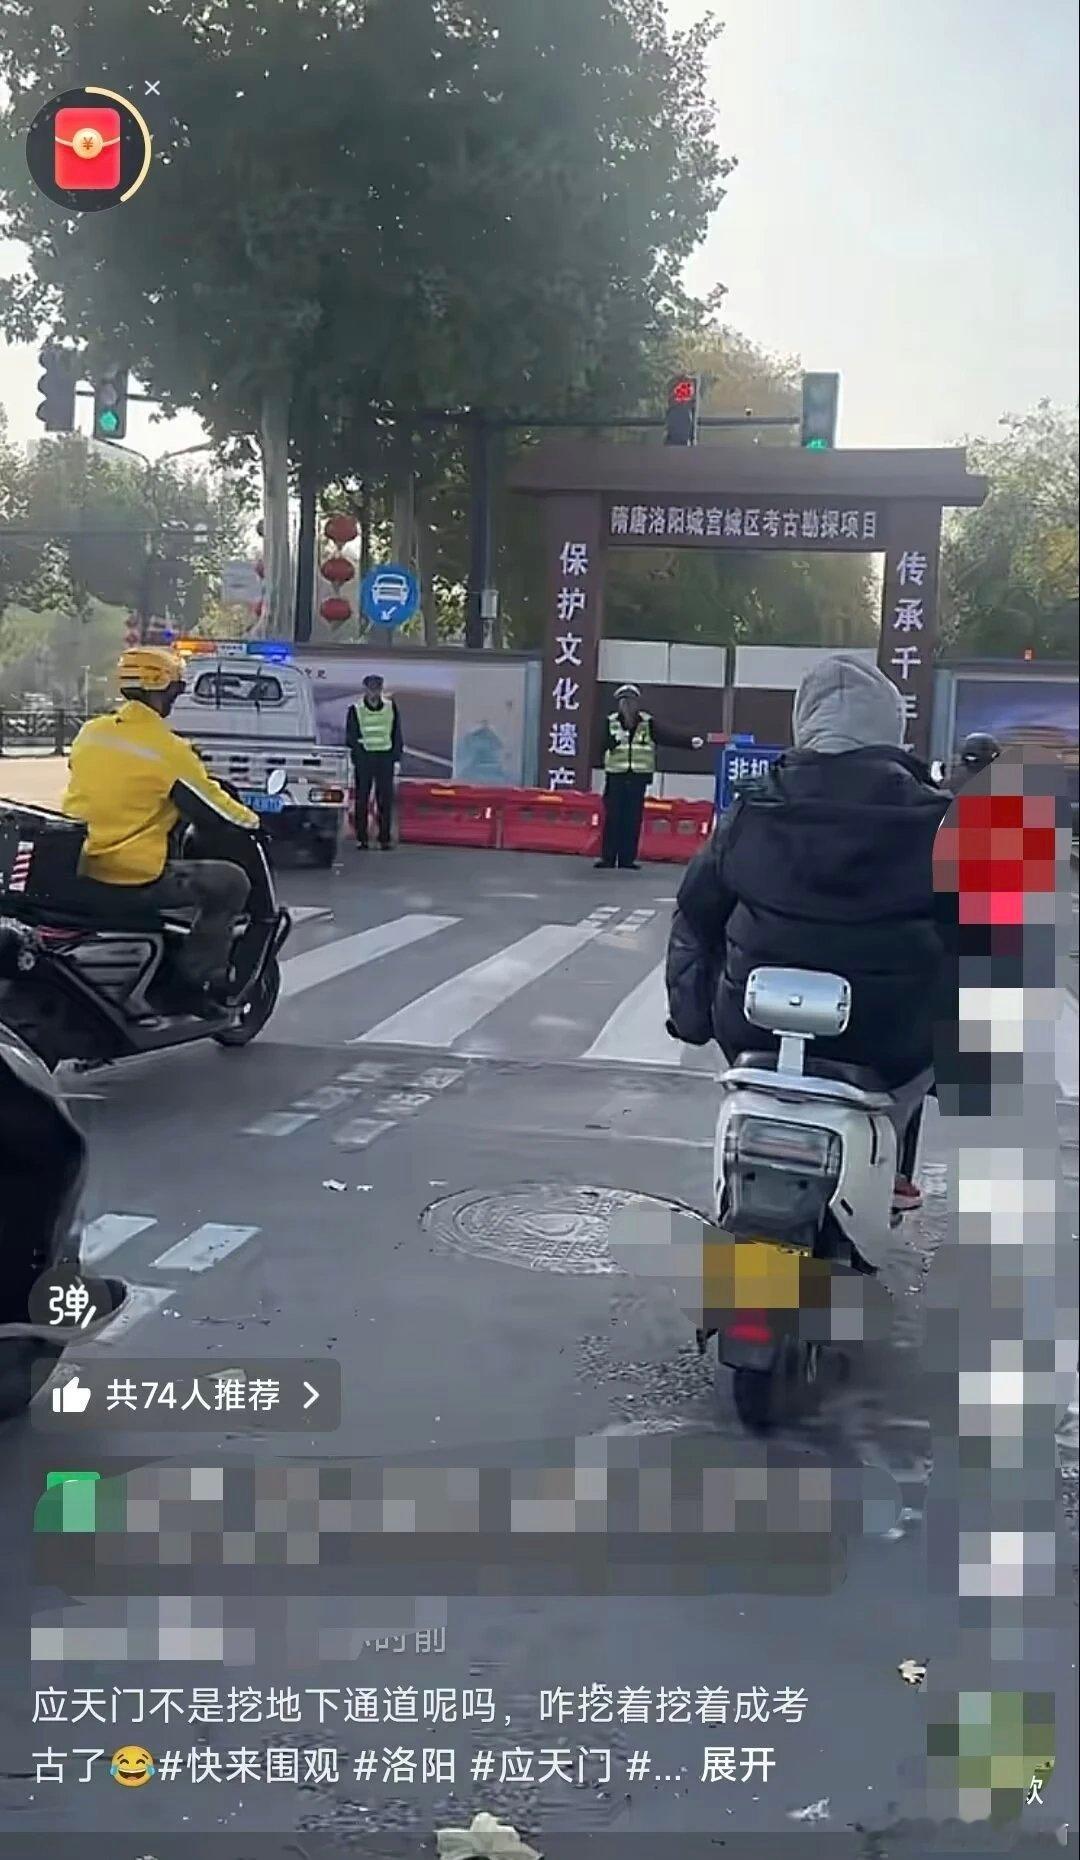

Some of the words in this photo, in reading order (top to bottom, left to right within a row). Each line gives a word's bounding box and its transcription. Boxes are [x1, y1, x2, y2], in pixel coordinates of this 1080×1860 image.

[610, 505, 877, 539] 隋唐洛阳城宫城区考古勘探项目
[549, 541, 589, 791] 保护文化遗产
[891, 551, 928, 752] 传承千年
